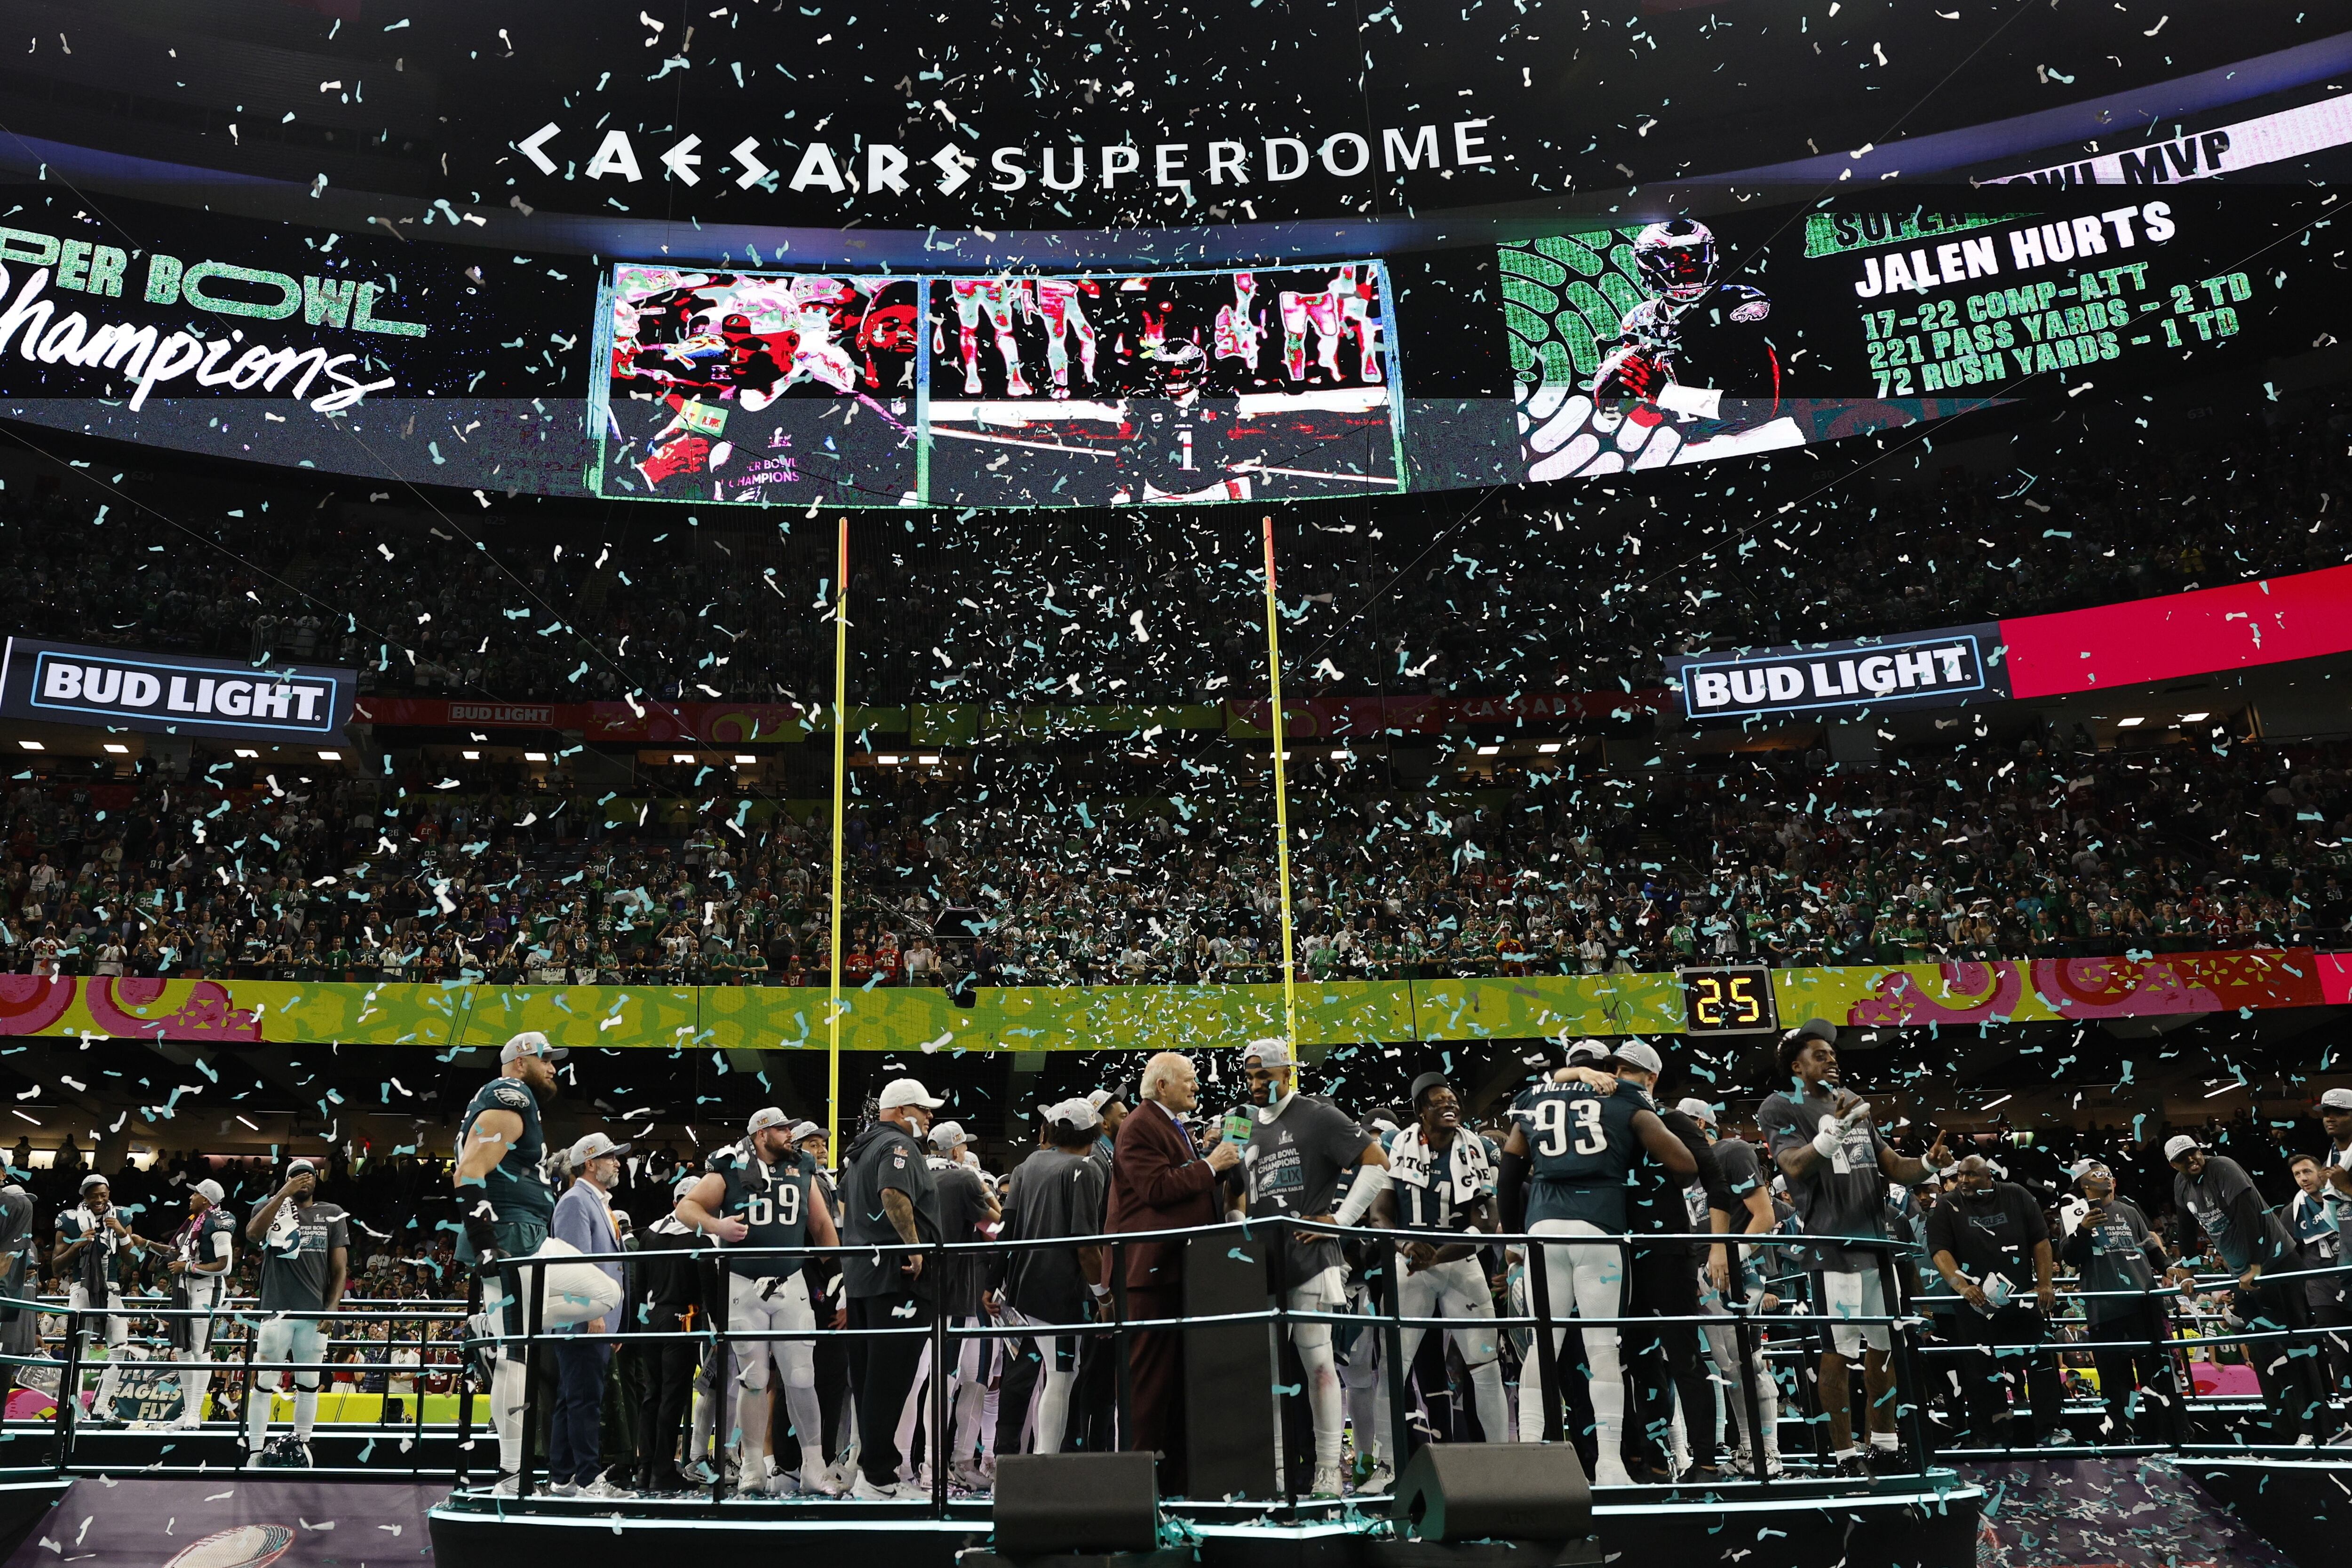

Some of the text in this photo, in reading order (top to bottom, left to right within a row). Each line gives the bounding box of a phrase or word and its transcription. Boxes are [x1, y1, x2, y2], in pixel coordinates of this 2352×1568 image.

[518, 120, 1492, 196] CAESARS SUPERDOME
[2120, 131, 2230, 183] MVP
[1855, 201, 2176, 298] JALEN HURTS
[144, 254, 427, 337] BOWL
[1861, 262, 2149, 341] 17-22 COMP-ATT
[0, 261, 395, 412] hampions
[1867, 335, 1925, 369] 221
[1931, 320, 2015, 359] PASS
[2021, 298, 2130, 342] YARDS
[2170, 284, 2194, 314] 2
[2201, 272, 2253, 306] TD
[1871, 368, 1914, 398] 72
[1921, 352, 2006, 391] RUSH
[2012, 333, 2121, 375] YARDS
[2161, 318, 2182, 348] 1
[2190, 307, 2240, 342] TD
[44, 662, 325, 720] BUD LIGHT
[1694, 647, 1967, 707] BUD LIGHT
[453, 707, 549, 722] BUD LIGHT
[1104, 932, 1116, 942] 26
[790, 975, 800, 987] 87
[883, 955, 895, 967] 15
[1697, 977, 1759, 1024] 25
[1534, 1099, 1607, 1157] 93
[1843, 1136, 1872, 1145] CHAMPION
[1258, 1148, 1300, 1166] SUPER BOWL
[1258, 1156, 1301, 1174] CHAMPIONS
[1280, 1169, 1301, 1183] LIX
[748, 1184, 801, 1226] 69
[1259, 1187, 1287, 1198] PHILADELPHIA
[1405, 1180, 1454, 1228] 11
[116, 1381, 183, 1401] EAGLES
[136, 1402, 174, 1420] FLY
